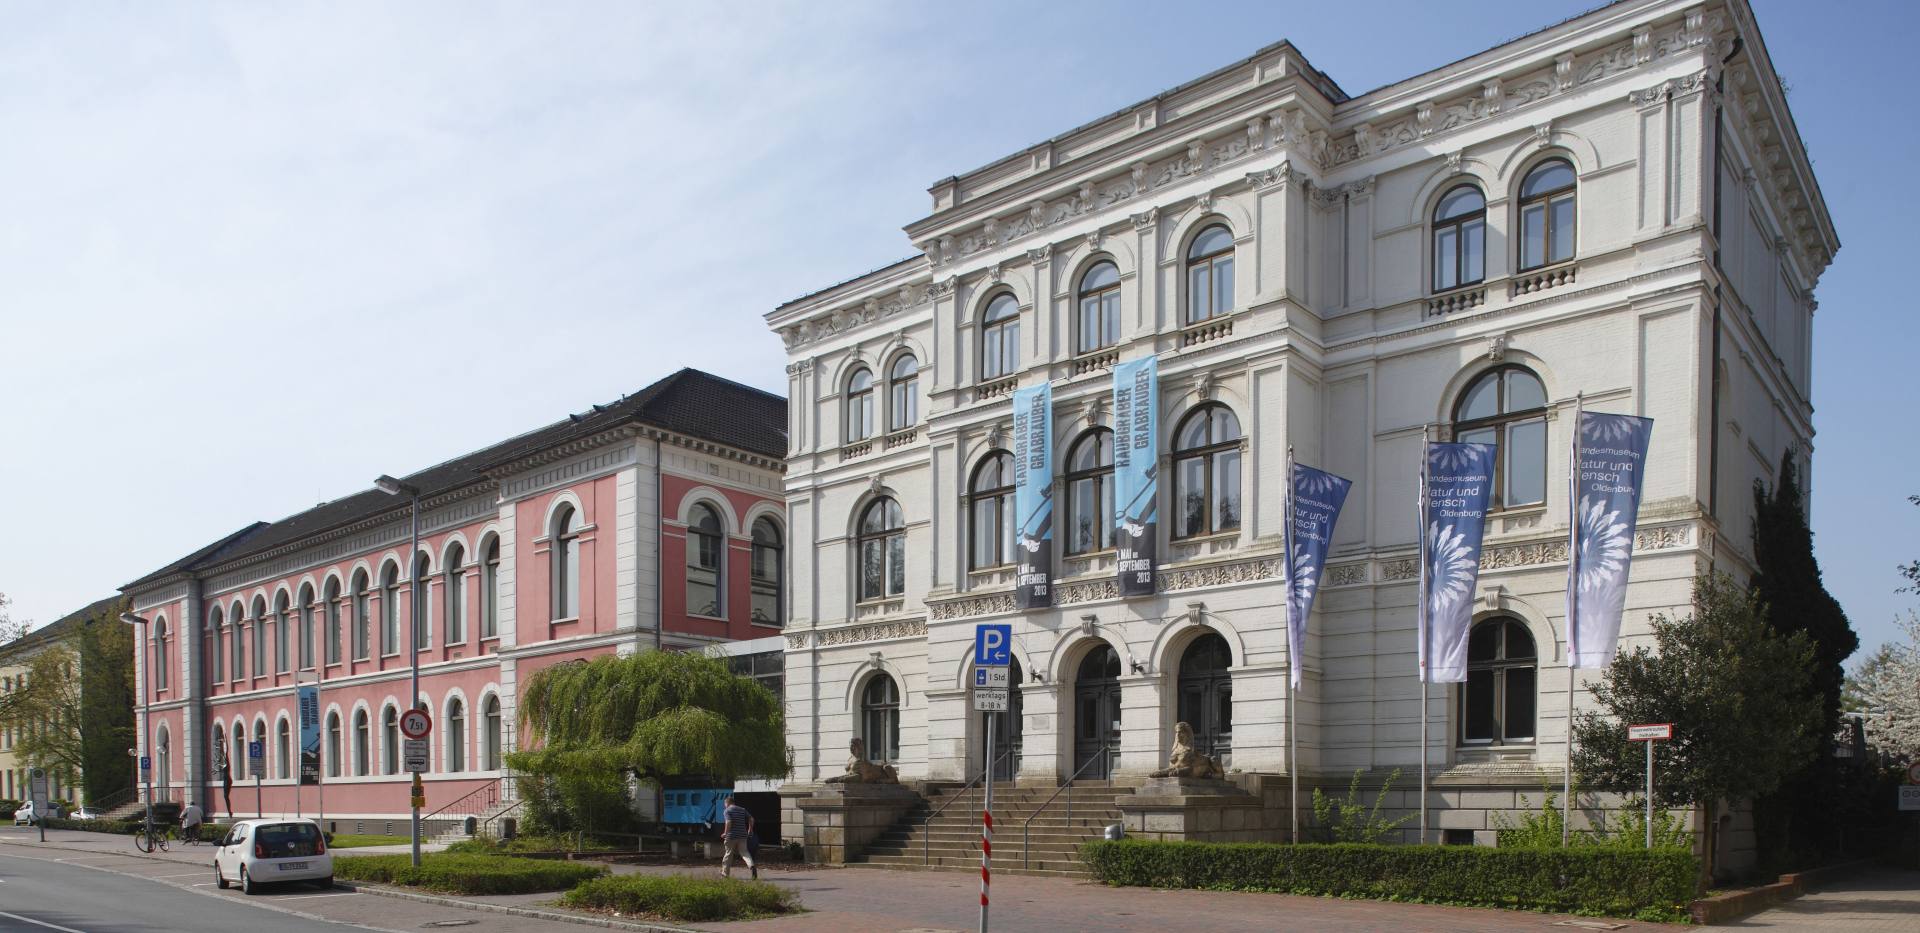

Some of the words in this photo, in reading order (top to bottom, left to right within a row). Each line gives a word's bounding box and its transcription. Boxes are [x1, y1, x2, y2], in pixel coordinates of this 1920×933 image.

[1580, 447, 1640, 460] andesmuseum
[1580, 459, 1607, 470] atur
[1430, 474, 1487, 483] andesmuseum
[1580, 470, 1620, 483] ensch
[1456, 485, 1480, 497] und
[1309, 512, 1329, 524] und
[1439, 509, 1482, 519] Oldenburg
[1120, 547, 1132, 560] MAI
[1119, 559, 1151, 572] SEPTEMBER
[1136, 571, 1151, 584] 2013
[1034, 585, 1047, 596] 2013
[983, 629, 1003, 660] P
[976, 692, 1006, 701] werktags
[252, 743, 260, 757] P
